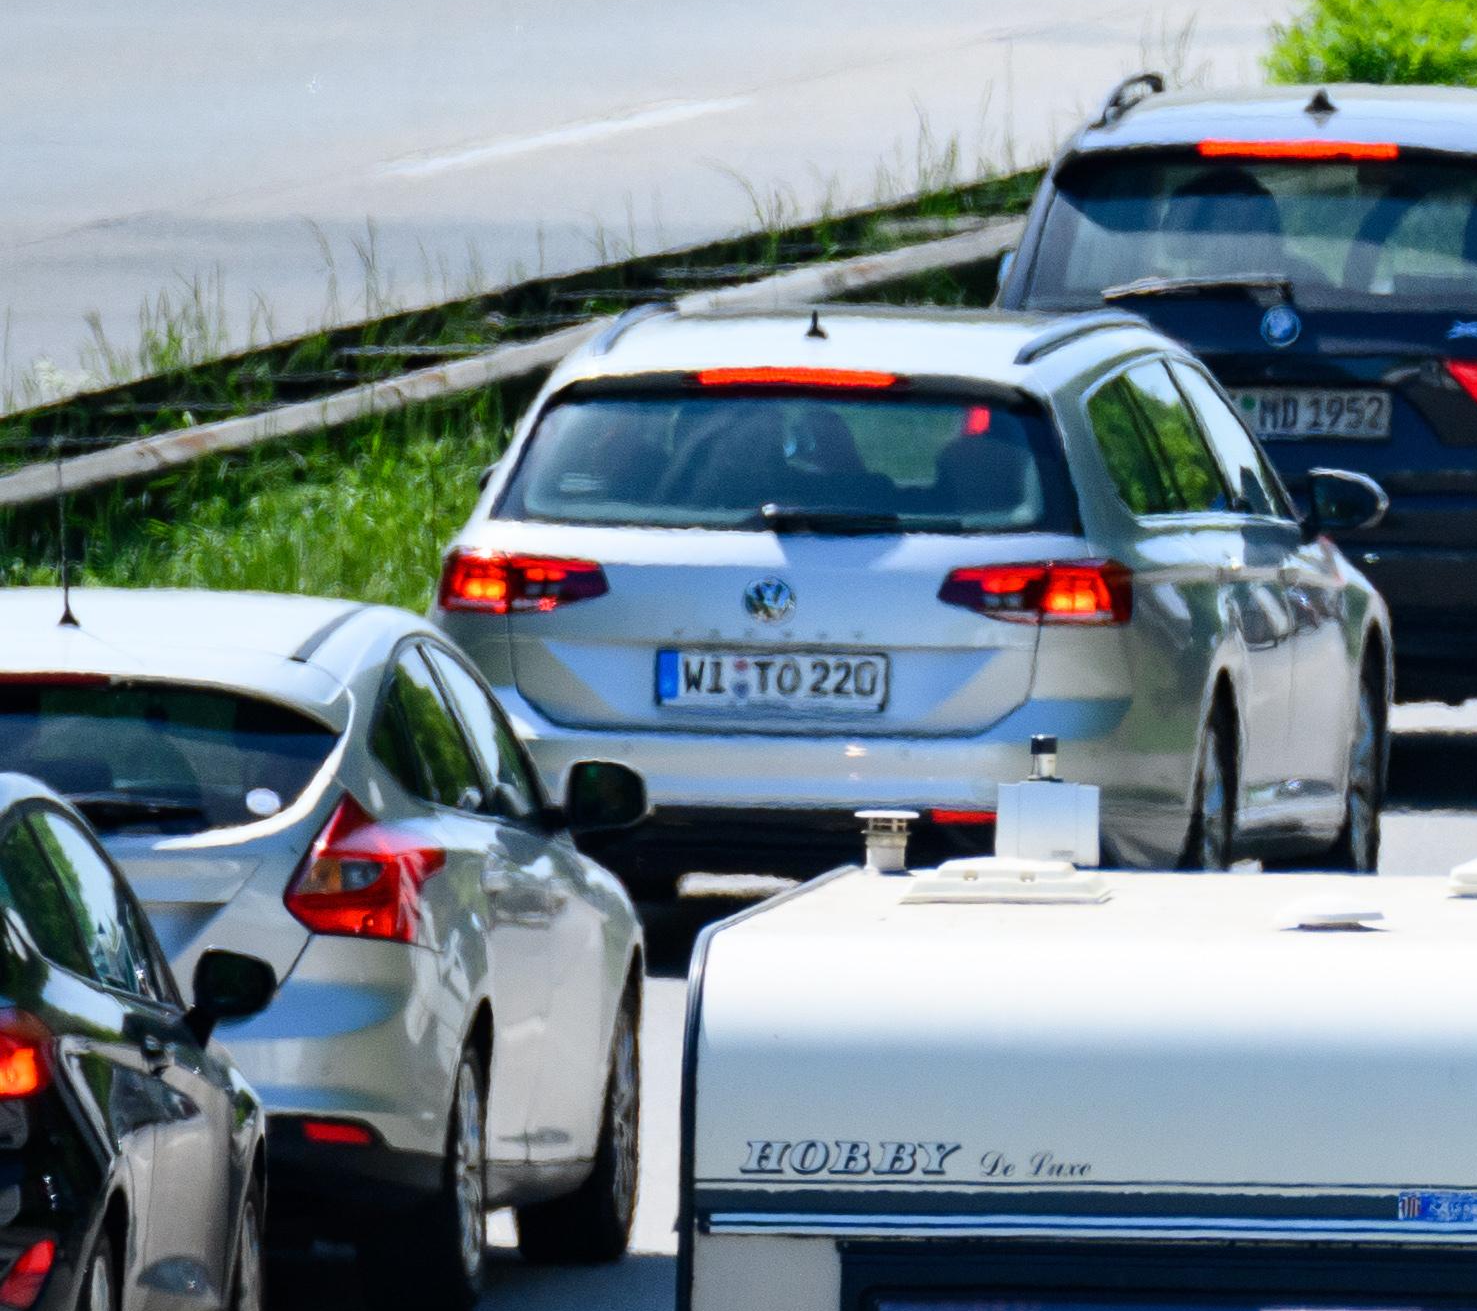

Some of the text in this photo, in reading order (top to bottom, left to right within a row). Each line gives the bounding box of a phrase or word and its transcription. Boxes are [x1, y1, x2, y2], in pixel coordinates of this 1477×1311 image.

[1309, 395, 1385, 431] 1952
[683, 659, 878, 697] WI TO 220
[739, 1139, 1093, 1179] HOBBY De Luxe
